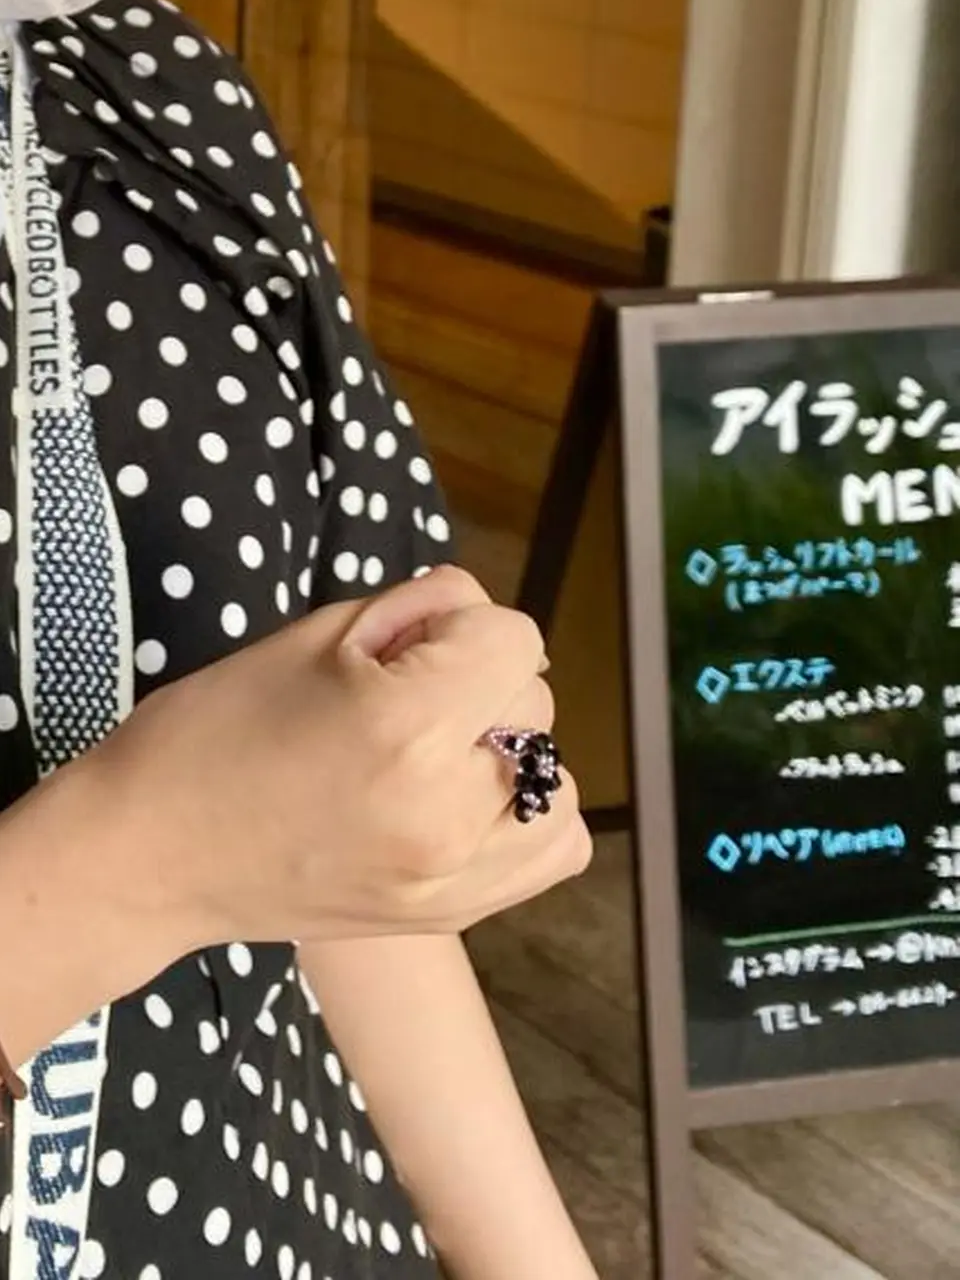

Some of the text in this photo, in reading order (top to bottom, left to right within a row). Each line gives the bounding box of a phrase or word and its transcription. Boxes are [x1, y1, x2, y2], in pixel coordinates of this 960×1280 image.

[26, 258, 61, 396] BOTTLES
[730, 656, 836, 692] エクステ
[753, 1002, 823, 1034] TEL
[26, 1010, 101, 1280] UBA
